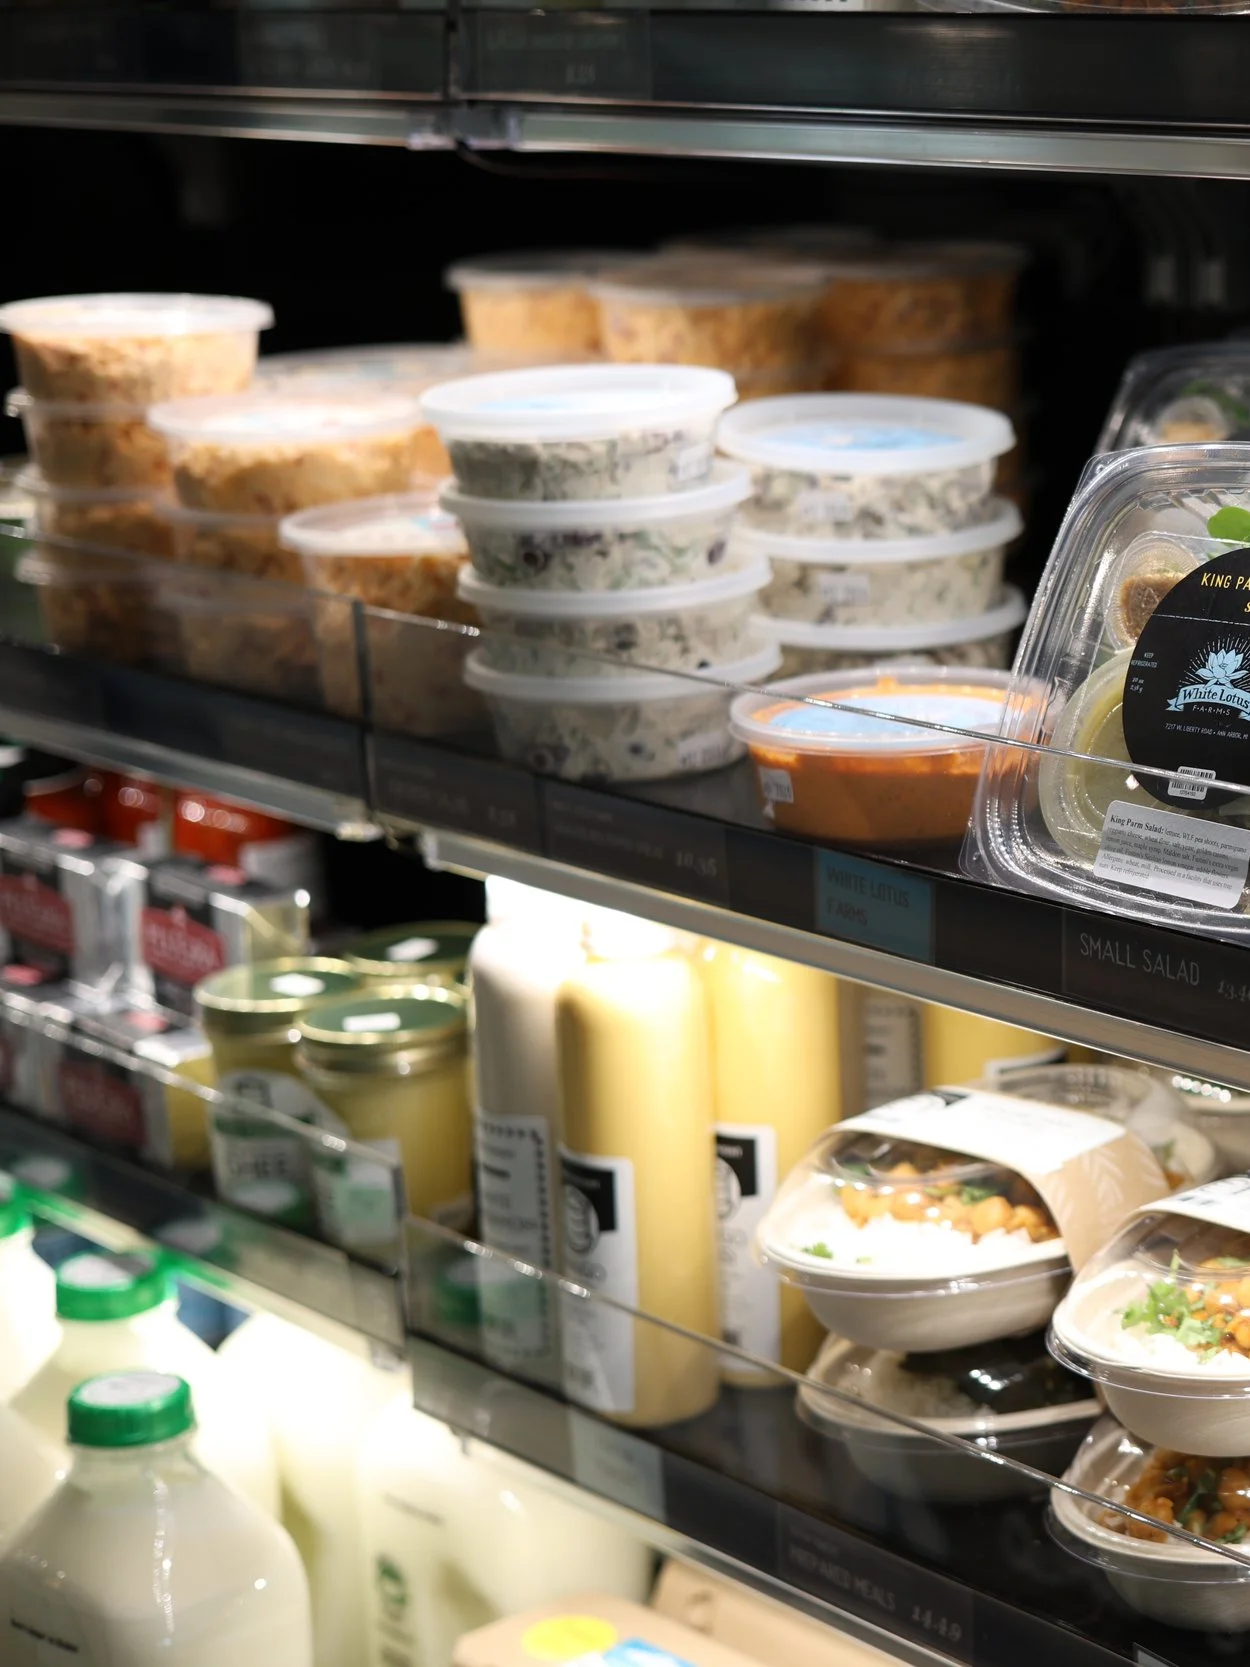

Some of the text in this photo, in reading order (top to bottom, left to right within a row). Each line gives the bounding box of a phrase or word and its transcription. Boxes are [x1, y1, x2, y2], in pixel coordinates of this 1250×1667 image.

[1201, 572, 1231, 589] KING
[1182, 688, 1250, 710] White Lotus
[1183, 725, 1200, 734] LIBERTY
[1109, 814, 1126, 826] King
[1125, 818, 1144, 829] Parm
[1144, 822, 1164, 834] Salad:
[826, 865, 909, 908] WHITE LOTUS
[826, 896, 868, 926] FARMS
[1080, 932, 1136, 969] SMALL
[1142, 949, 1200, 986] SALAD
